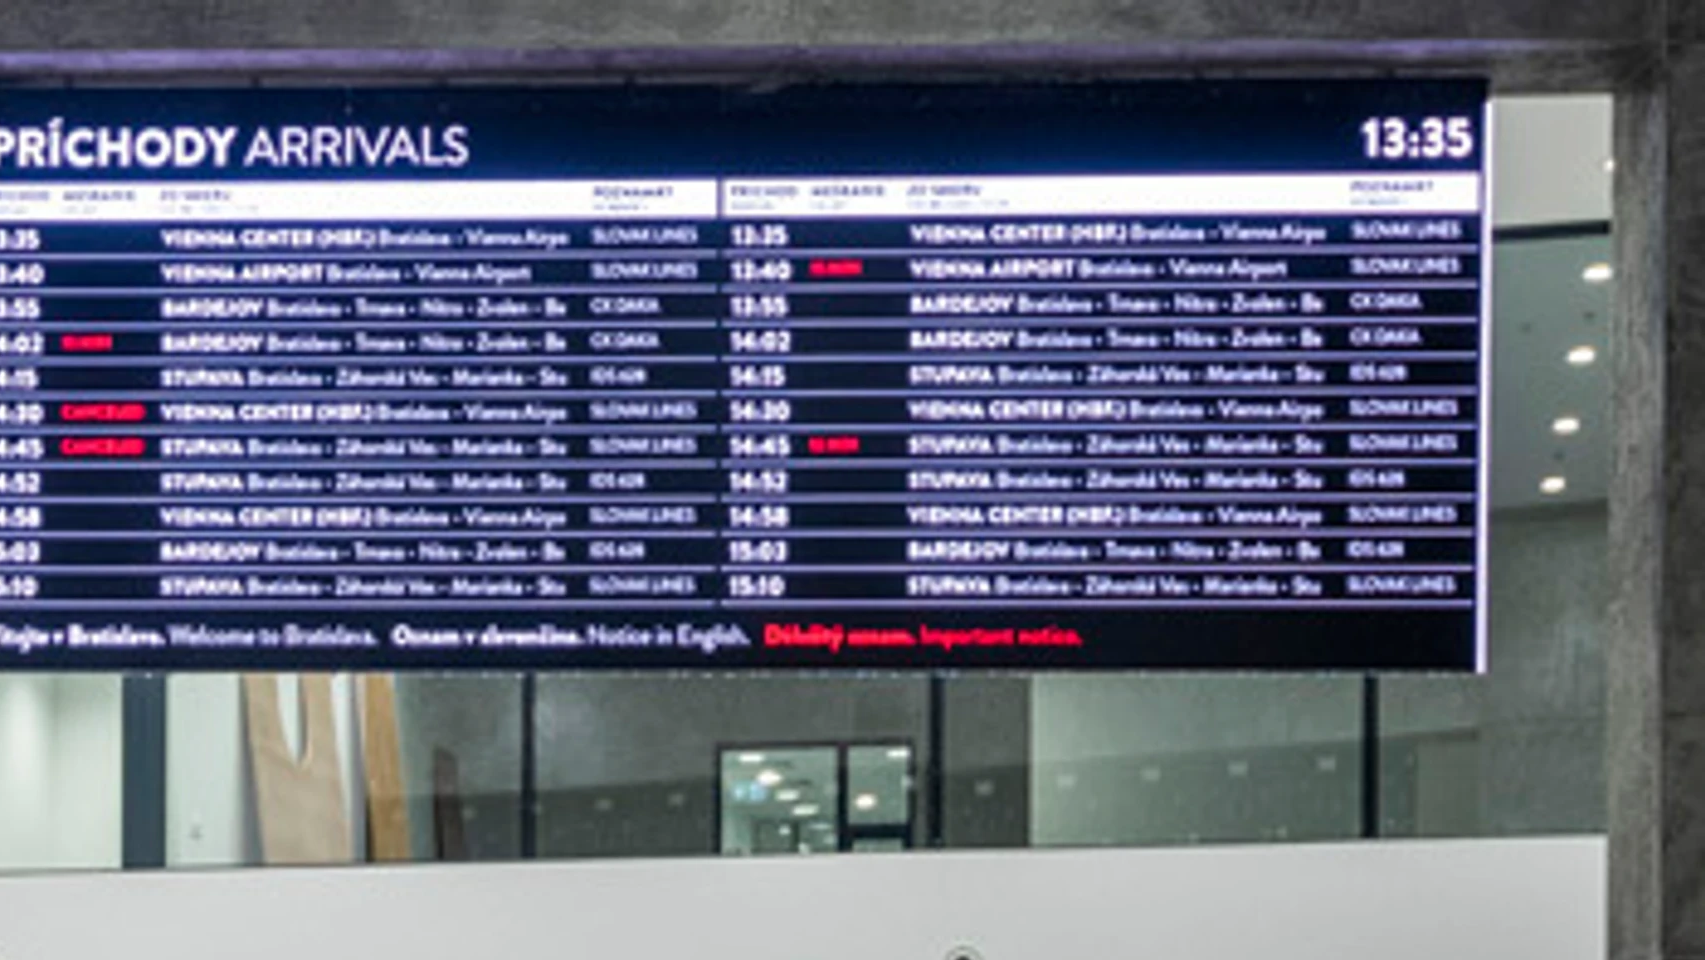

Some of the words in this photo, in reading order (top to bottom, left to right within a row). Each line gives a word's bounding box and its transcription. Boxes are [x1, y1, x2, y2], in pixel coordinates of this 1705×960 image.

[244, 126, 469, 166] ARRIVALS
[1363, 117, 1472, 158] 13:35
[732, 225, 788, 245] 13:35
[731, 259, 791, 281] 13:40
[731, 295, 788, 317] 13:55
[731, 331, 791, 352] 14:02
[731, 365, 785, 386] 14:15
[731, 400, 790, 421] 14:30
[730, 434, 790, 457] 14:45
[730, 469, 788, 492] 14:52
[730, 506, 789, 527] 14:58
[730, 541, 787, 561] 15:03
[730, 575, 785, 596] 15:10
